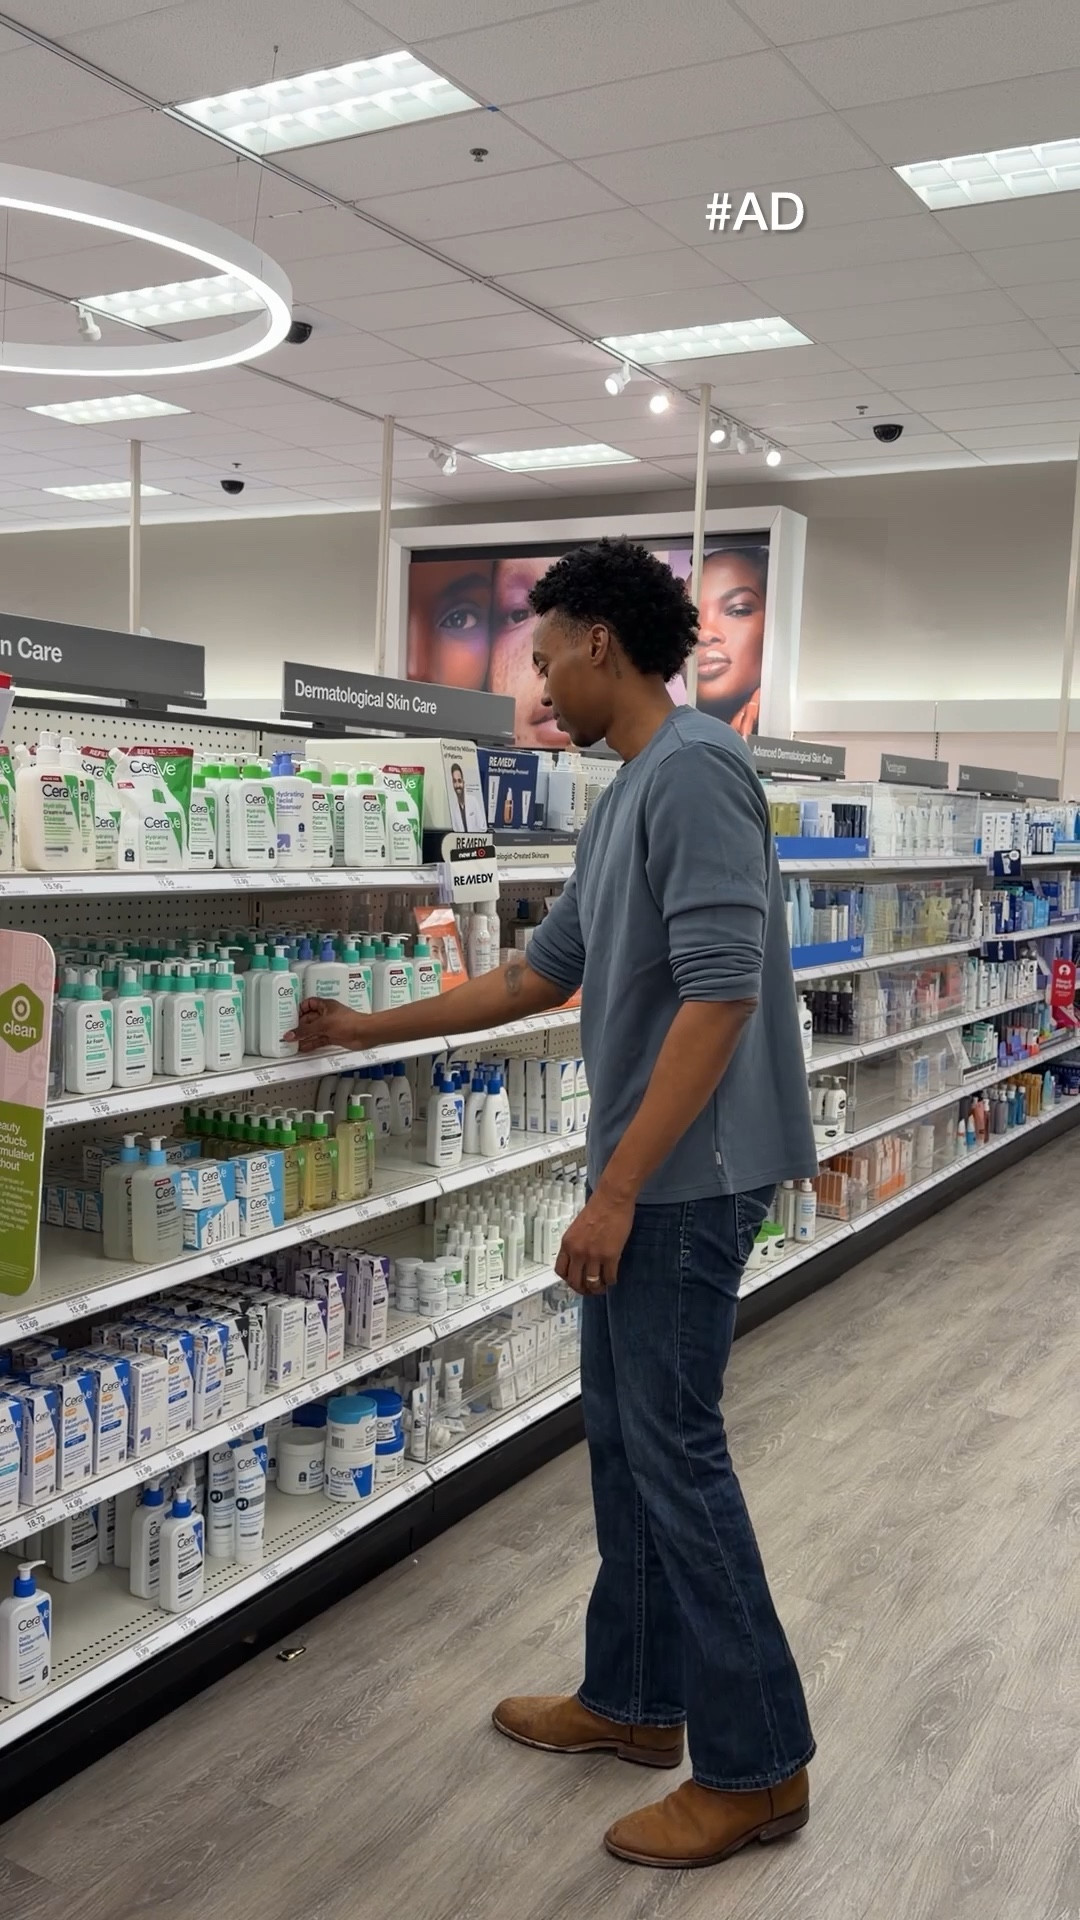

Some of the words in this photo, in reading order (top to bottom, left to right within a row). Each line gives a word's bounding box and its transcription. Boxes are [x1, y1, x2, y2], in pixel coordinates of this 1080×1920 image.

[17, 636, 63, 664] Care
[294, 679, 384, 709] Dermatological
[386, 692, 410, 712] Skin
[412, 696, 437, 715] Care
[136, 748, 156, 756] REFILL
[752, 744, 777, 760] Advanced
[777, 747, 811, 765] Dermatological
[811, 752, 822, 764] Skin
[821, 753, 833, 765] Care
[129, 760, 177, 776] CeraVe
[488, 756, 517, 768] REMEDY
[383, 775, 416, 790] CeraVe
[42, 783, 79, 800] CeraVe
[245, 794, 274, 804] CeraVe
[190, 803, 215, 814] CeraVe
[144, 816, 181, 829] CeraVe
[531, 851, 550, 859] Skincare
[453, 872, 494, 887] REMEDY
[316, 979, 340, 987] Foaming
[3, 1020, 37, 1039] clean
[250, 1158, 276, 1172] CeraVe
[202, 1168, 227, 1183] CeraVe
[249, 1194, 276, 1210] CeraVe
[101, 1376, 129, 1393] CeraVe
[64, 1389, 93, 1408] CeraVe
[212, 1450, 233, 1463] Cera
[237, 1451, 267, 1470] CeraVe
[329, 1466, 363, 1479] CeraVe
[65, 1497, 83, 1511] 14.99
[26, 1514, 46, 1529] 18.79
[18, 1609, 50, 1632] CeraVe
[19, 1634, 31, 1643] Daily
